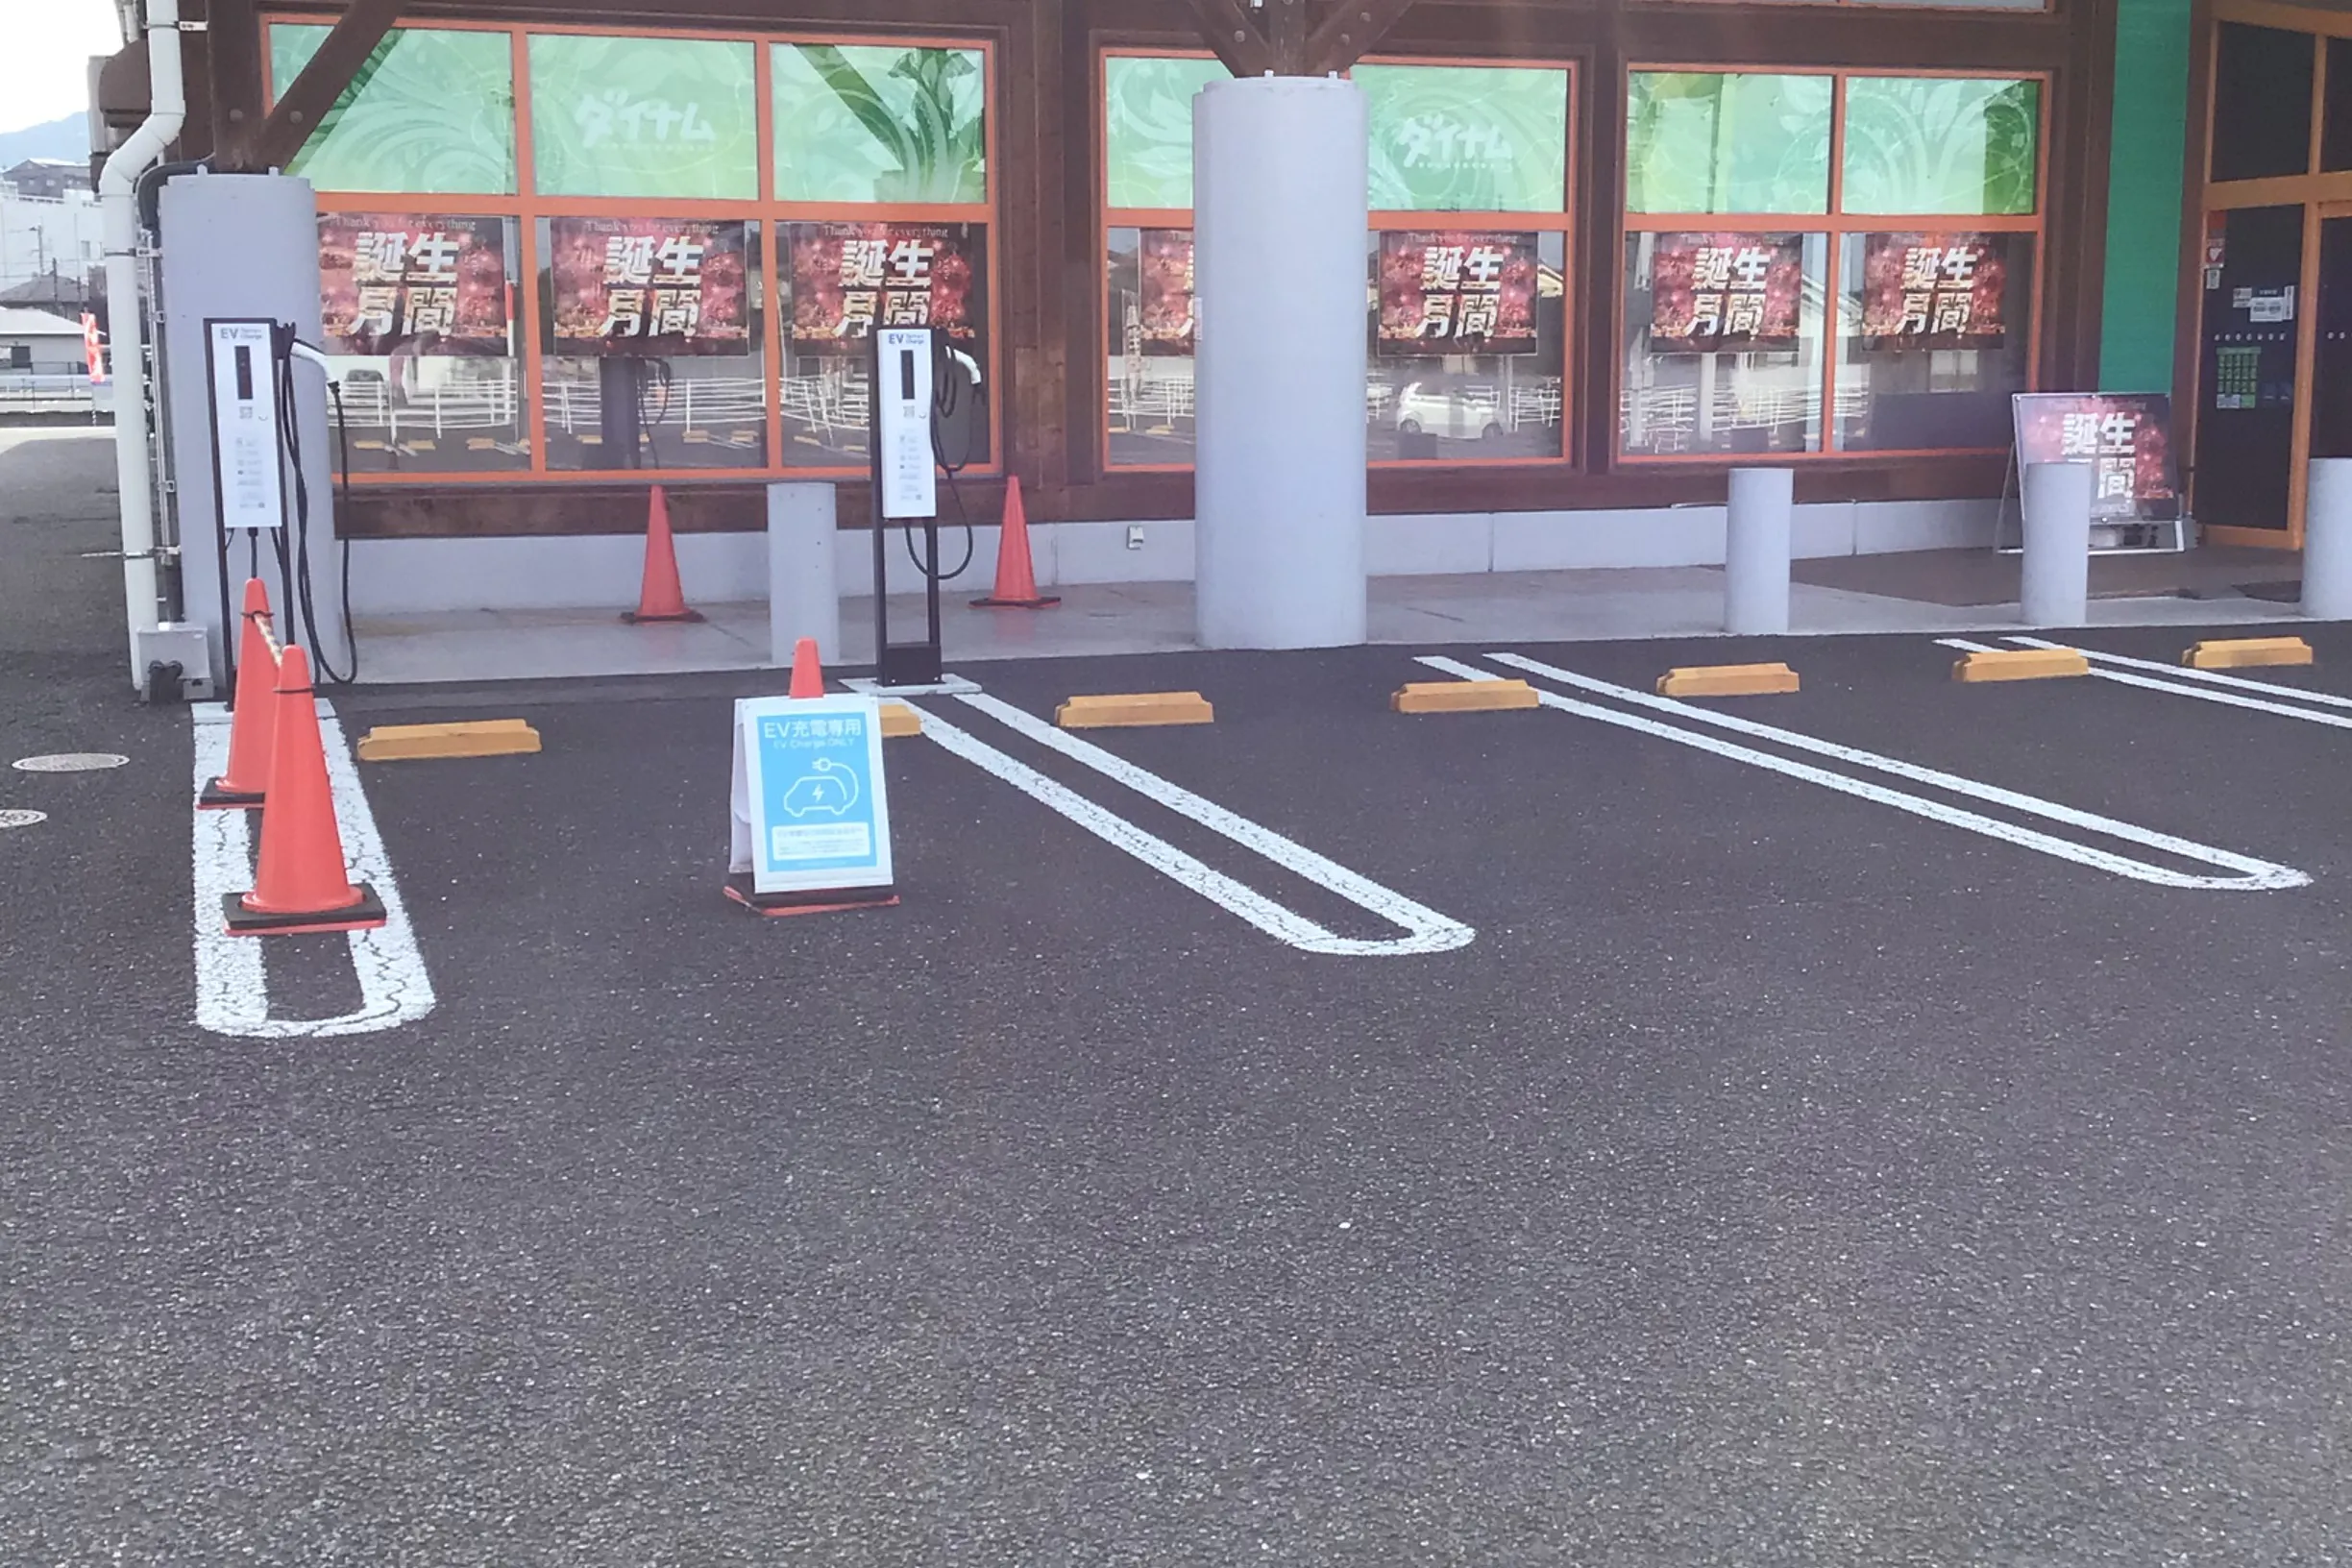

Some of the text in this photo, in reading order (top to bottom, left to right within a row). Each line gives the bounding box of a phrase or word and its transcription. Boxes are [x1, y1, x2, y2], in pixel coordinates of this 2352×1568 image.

[575, 88, 716, 148] ダイナム
[1397, 113, 1512, 167] ダイナム
[352, 232, 459, 282] 誕生
[602, 235, 703, 284] 誕生
[838, 239, 934, 287] 誕生
[1419, 246, 1504, 290] 誕生
[1691, 246, 1771, 290] 誕生
[1899, 246, 1977, 290] 誕生
[220, 327, 239, 339] EV
[888, 332, 904, 344] EV
[2061, 412, 2136, 455] 誕生
[2068, 457, 2136, 500] 間
